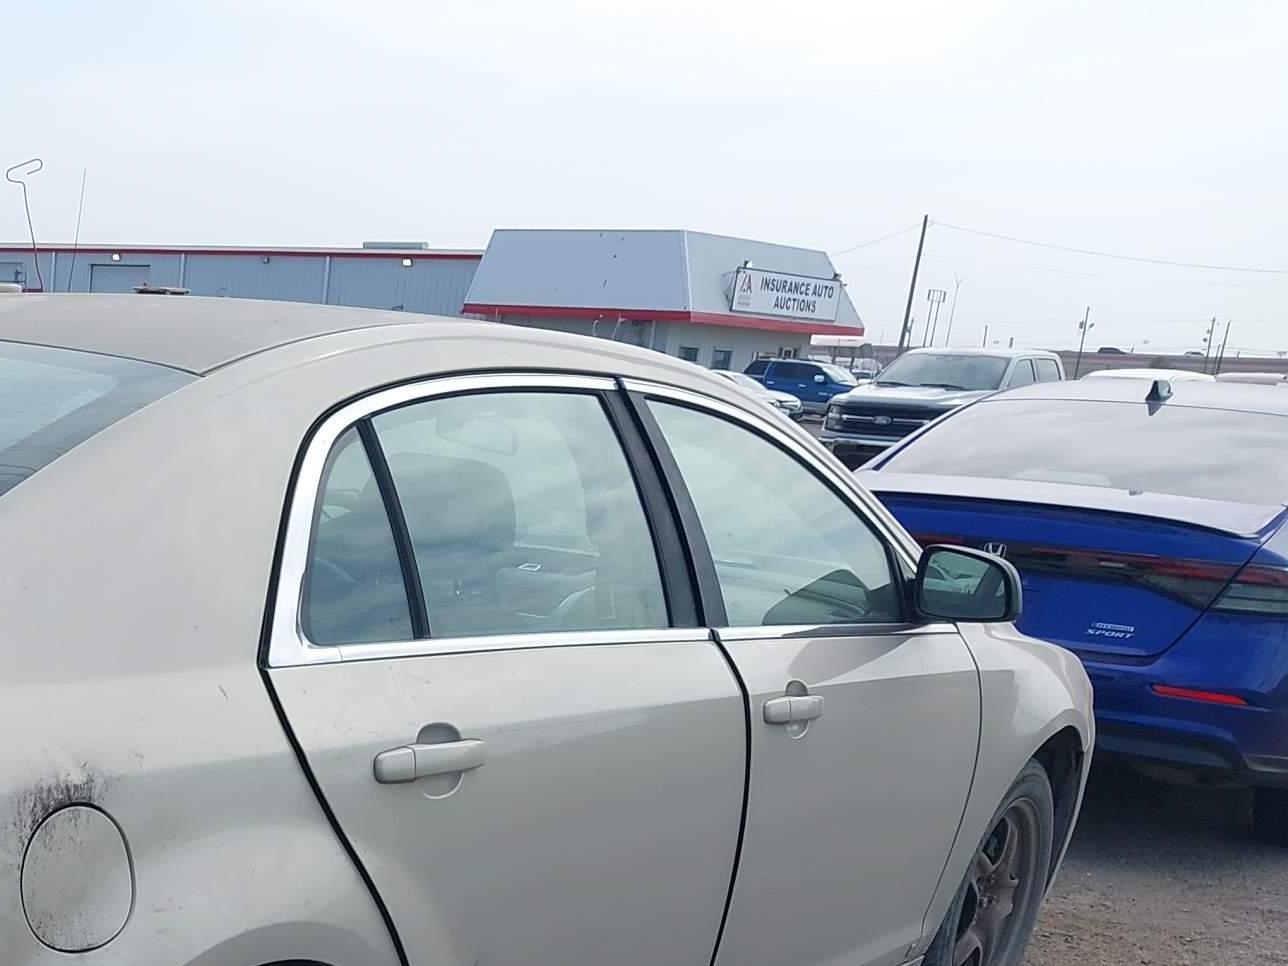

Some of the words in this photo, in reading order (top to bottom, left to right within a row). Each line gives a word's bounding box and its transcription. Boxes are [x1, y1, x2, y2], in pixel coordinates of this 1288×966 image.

[760, 277, 811, 297] INSURANCE
[811, 284, 834, 299] AUTO
[773, 296, 817, 314] AUCTIONS
[1085, 629, 1135, 638] SPORT
